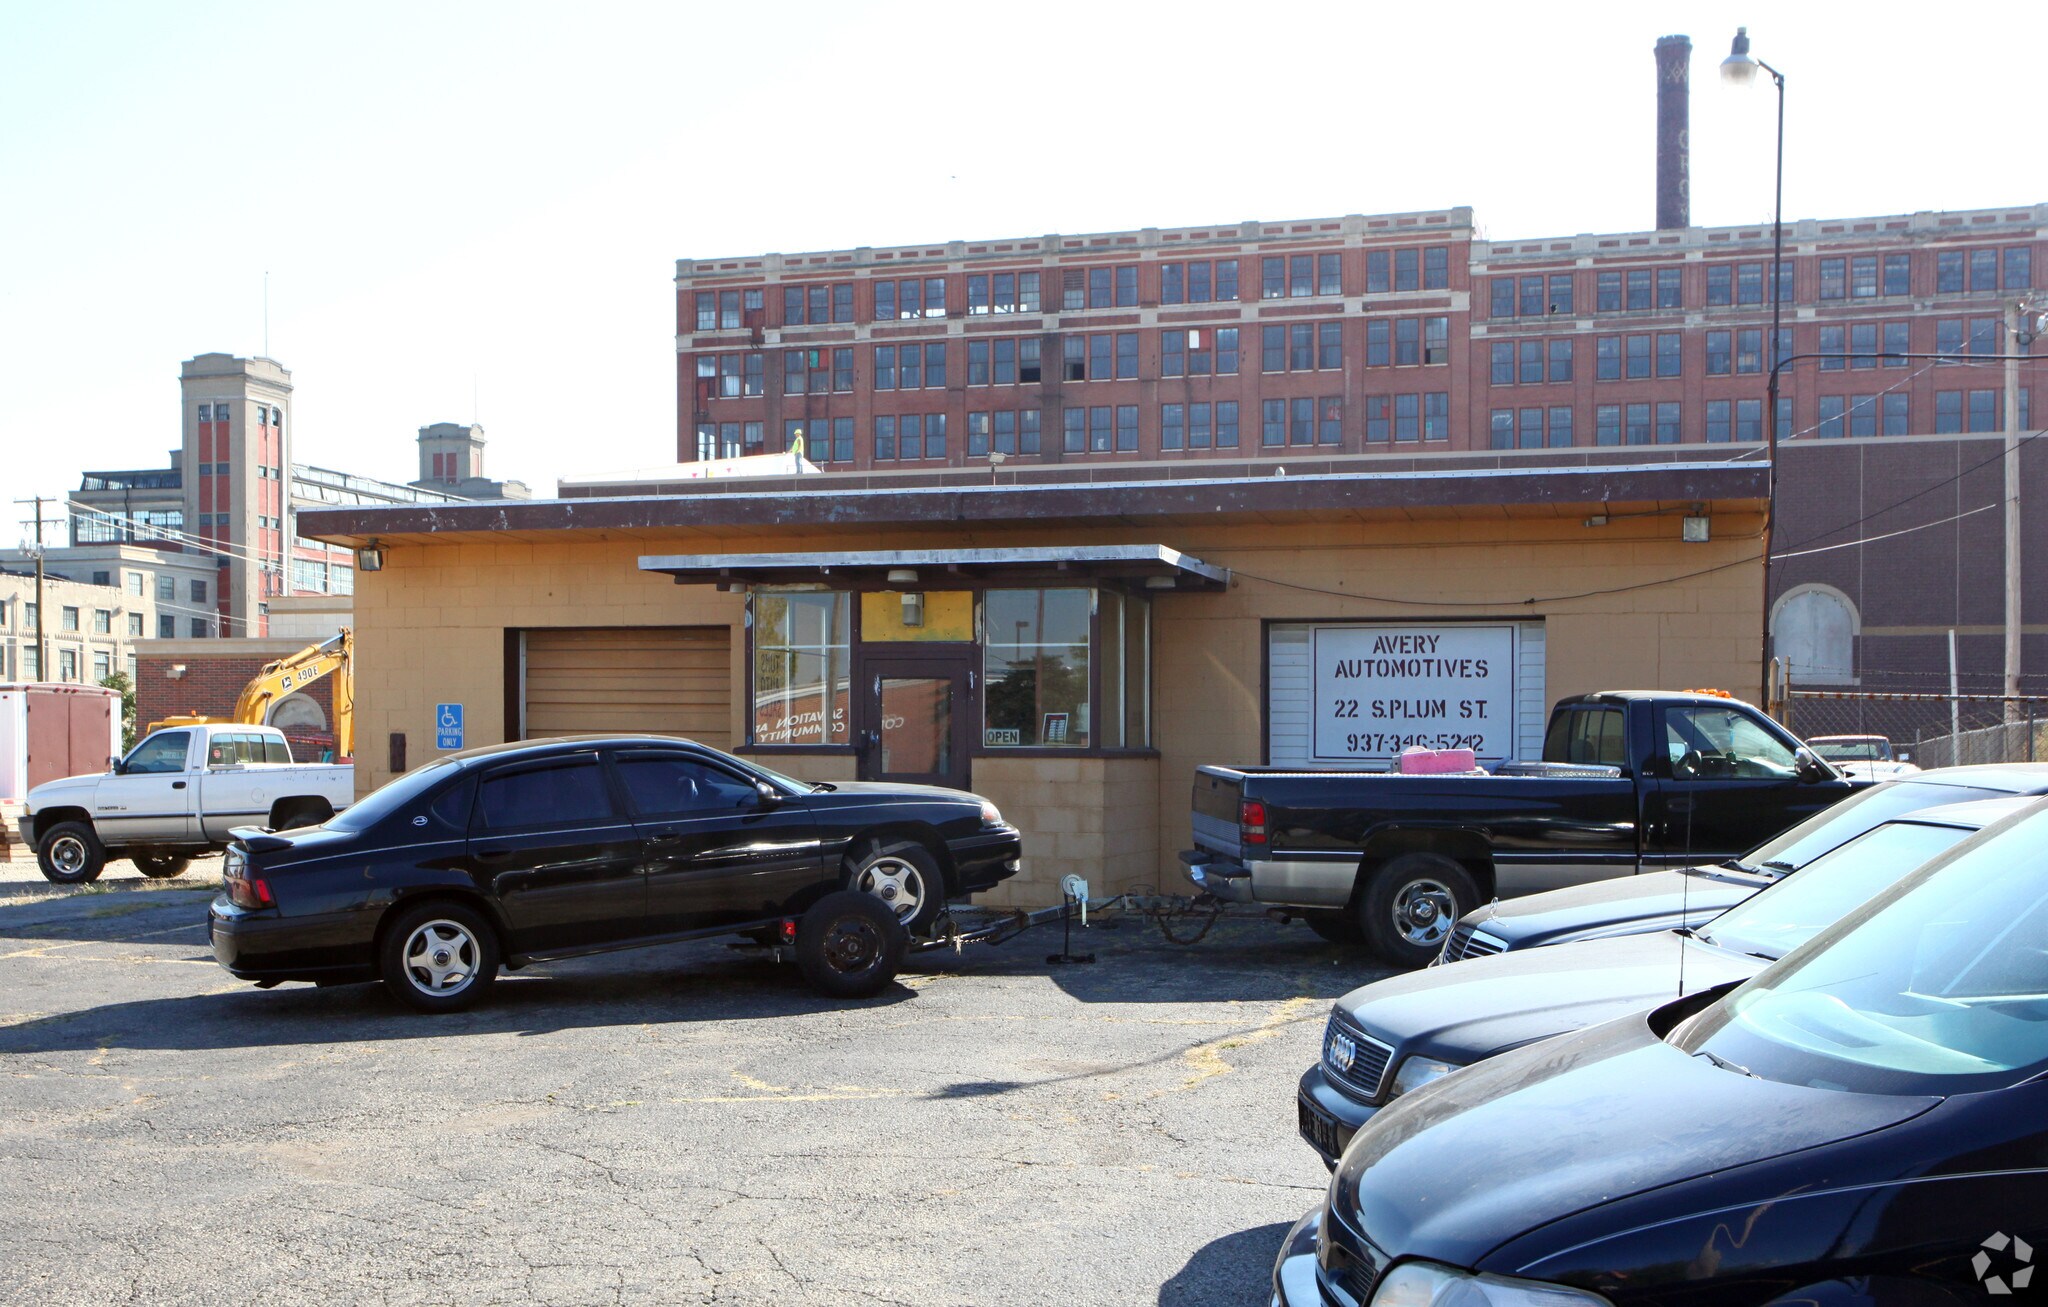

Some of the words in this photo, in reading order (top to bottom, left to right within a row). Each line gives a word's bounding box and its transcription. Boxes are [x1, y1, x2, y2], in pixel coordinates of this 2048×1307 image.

[1373, 635, 1440, 654] AVERY
[298, 665, 318, 681] 490E
[1334, 659, 1489, 678] AUTOMOTIVES
[1334, 700, 1359, 719] 22
[1459, 700, 1488, 719] ST.
[437, 727, 462, 736] PARKING
[987, 731, 1018, 743] OPEN
[442, 737, 457, 747] ONLY
